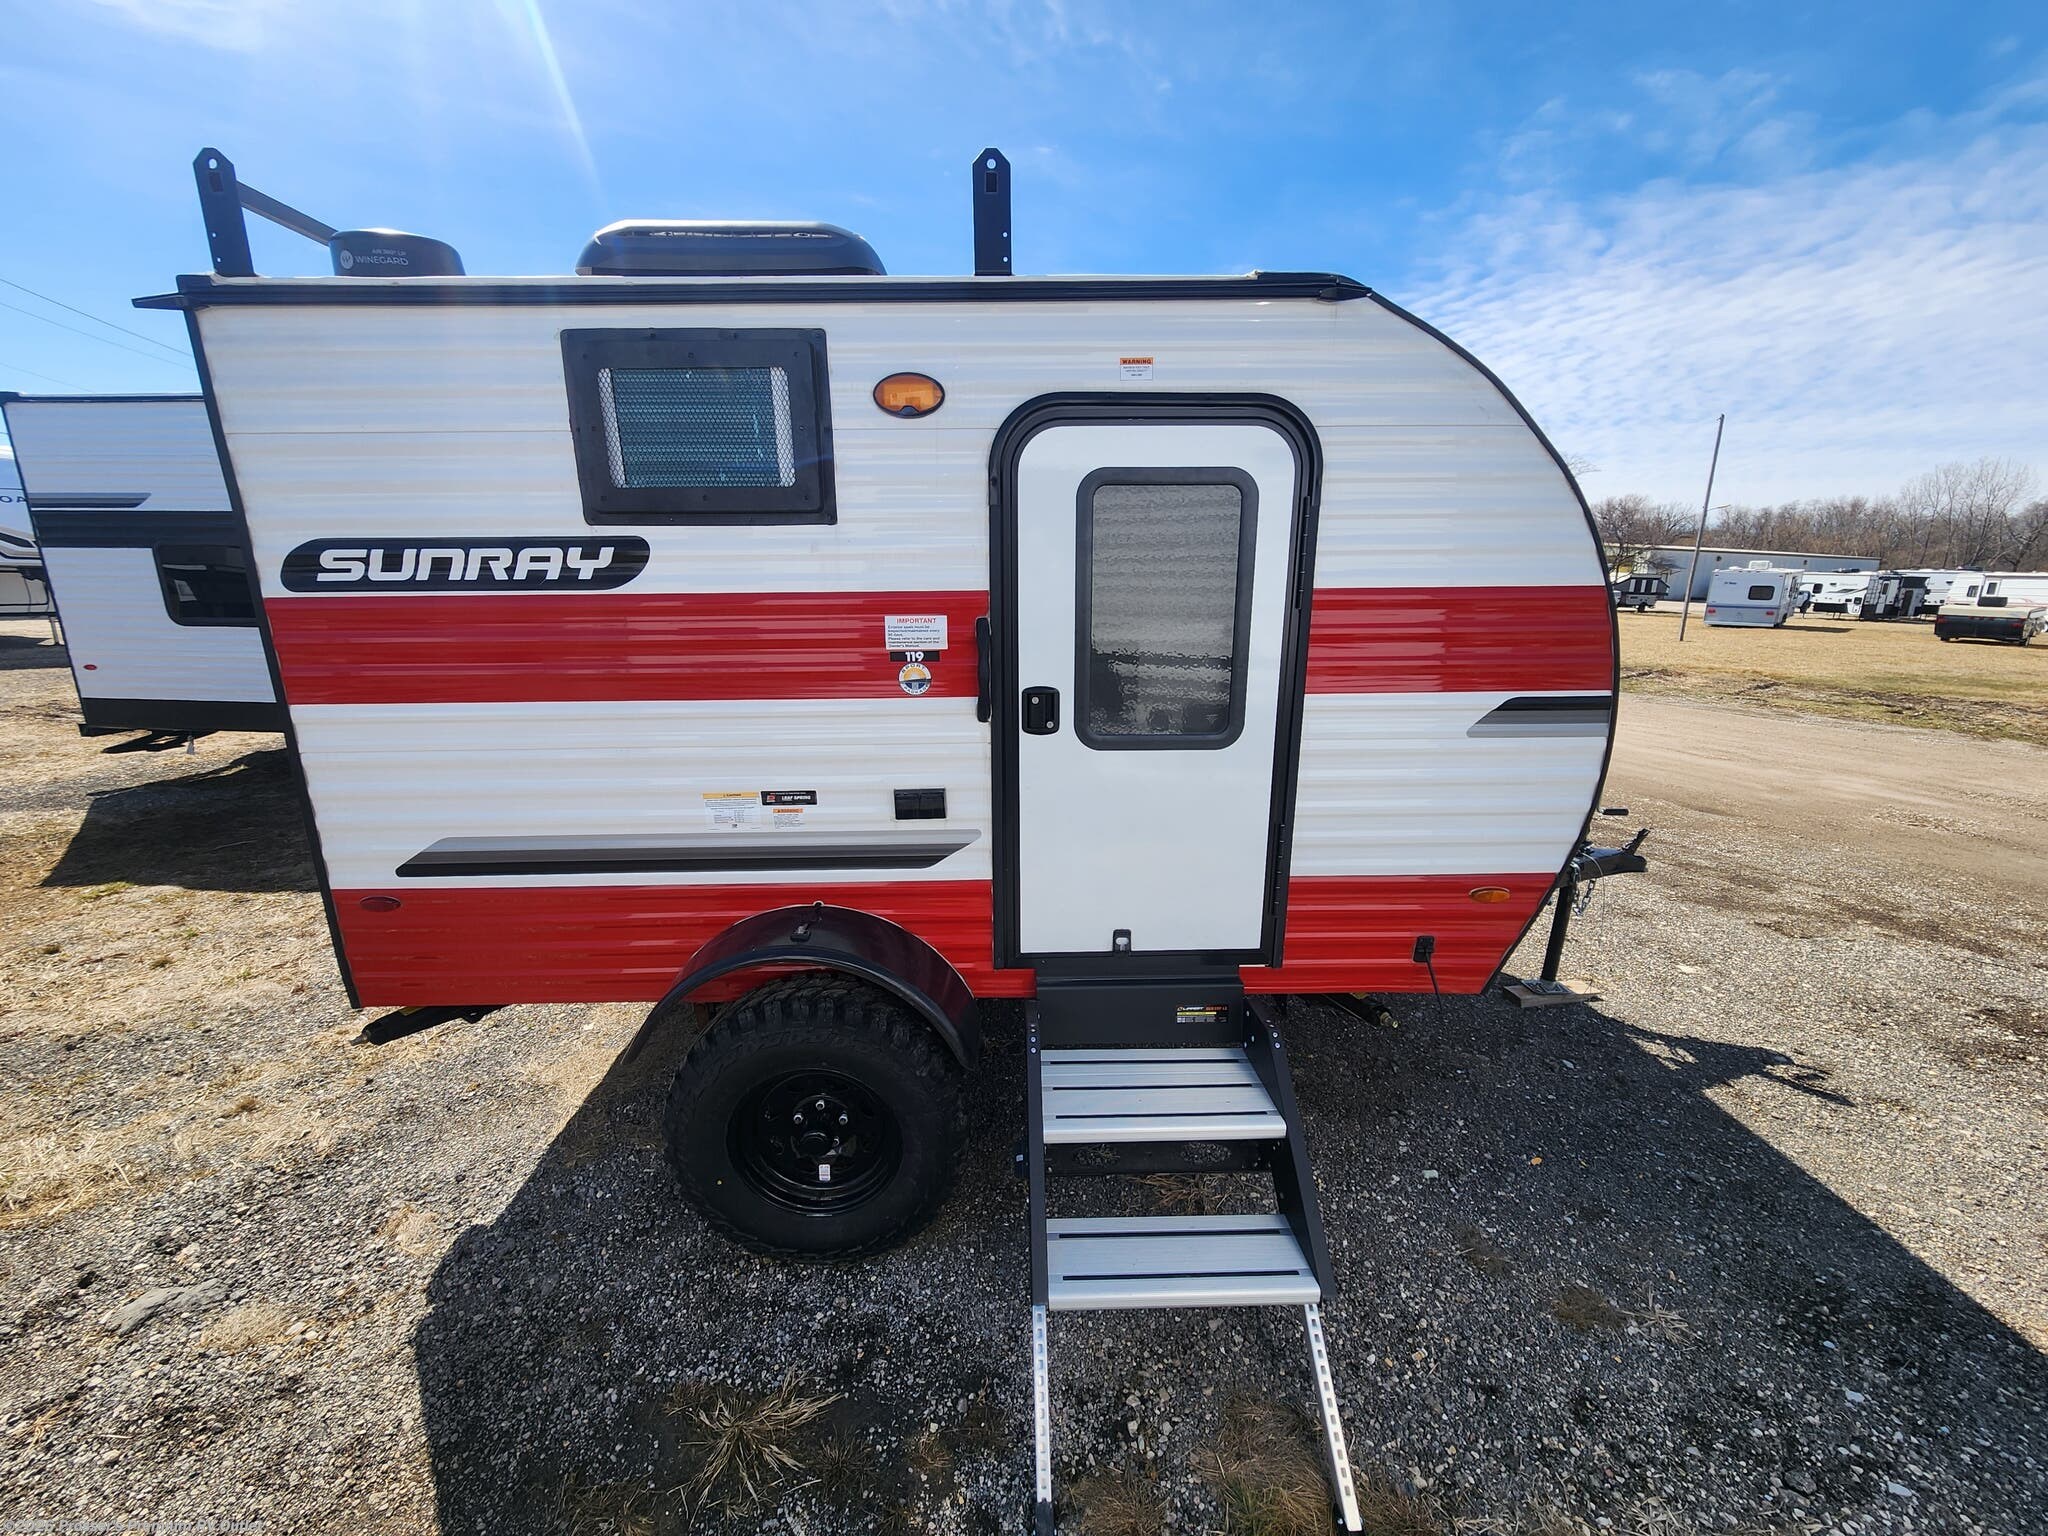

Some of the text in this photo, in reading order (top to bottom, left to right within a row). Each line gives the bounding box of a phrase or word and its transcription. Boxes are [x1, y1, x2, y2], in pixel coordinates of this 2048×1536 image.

[354, 255, 409, 266] WINEGARD
[316, 546, 615, 582] SUNRAY
[905, 651, 924, 662] 119
